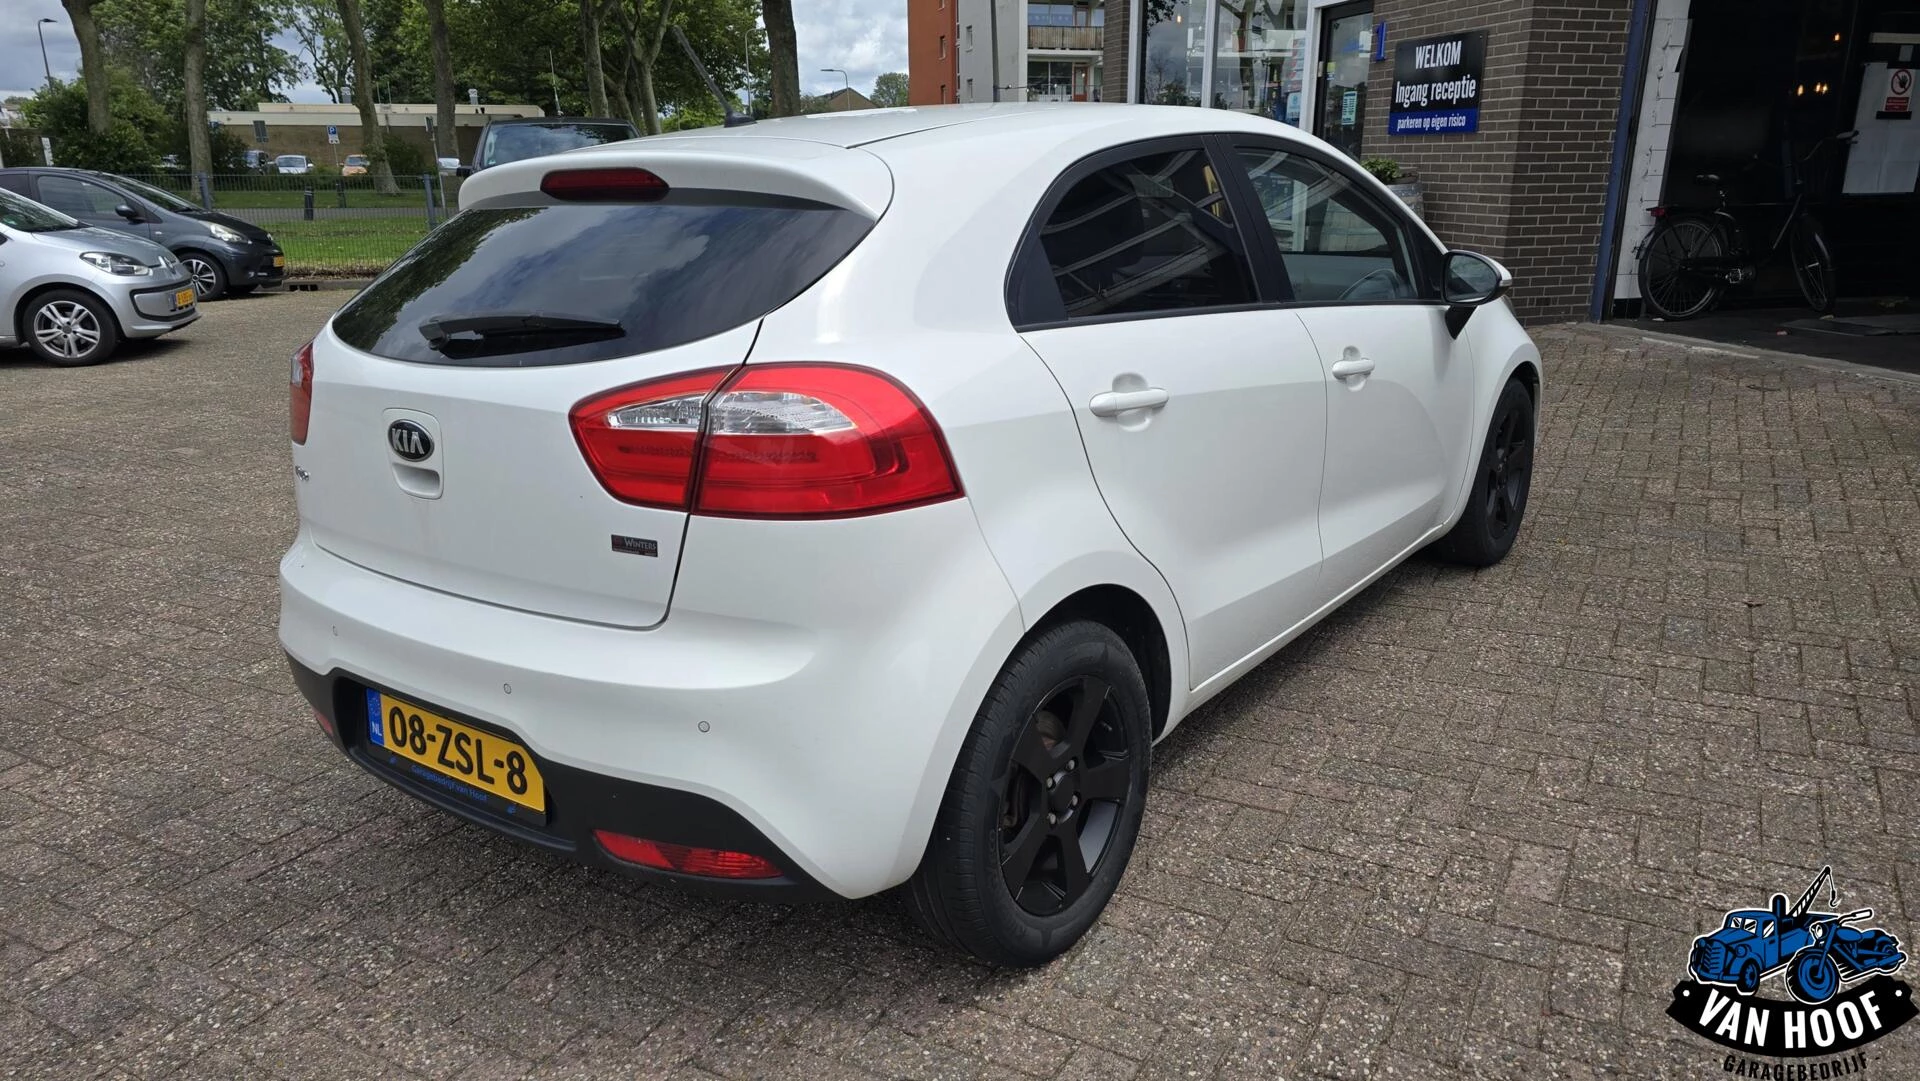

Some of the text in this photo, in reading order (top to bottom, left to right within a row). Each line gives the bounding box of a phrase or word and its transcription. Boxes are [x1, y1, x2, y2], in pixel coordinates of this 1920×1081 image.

[1376, 21, 1386, 61] 1
[1415, 40, 1462, 69] WELKOM
[1395, 74, 1476, 108] Ingang receptie
[1397, 113, 1466, 132] parkeren op eigen risico
[391, 428, 425, 455] KIA
[371, 721, 383, 737] NL
[389, 706, 528, 795] 08-ZSL-8
